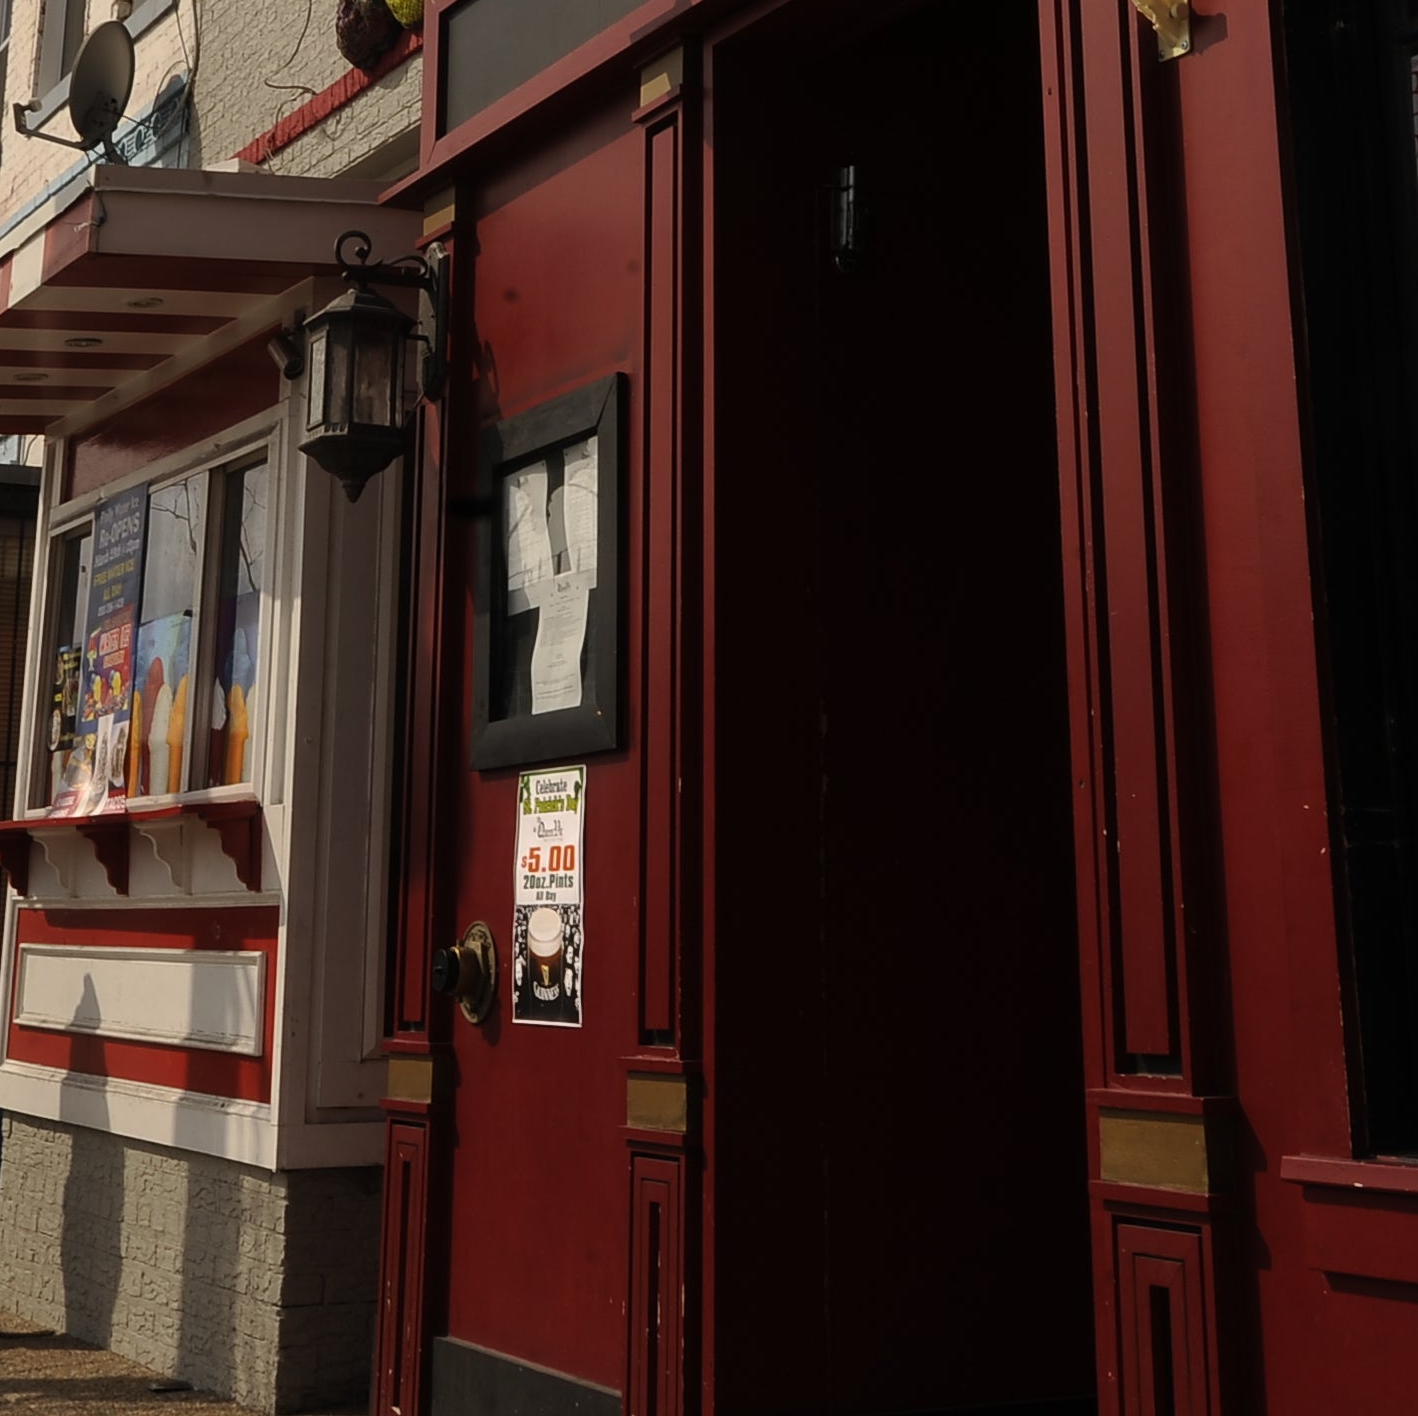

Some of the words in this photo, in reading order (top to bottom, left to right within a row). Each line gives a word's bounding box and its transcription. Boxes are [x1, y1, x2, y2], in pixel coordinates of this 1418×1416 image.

[535, 778, 568, 795] Celebrate
[521, 844, 575, 873] $5.00
[545, 891, 557, 902] Day
